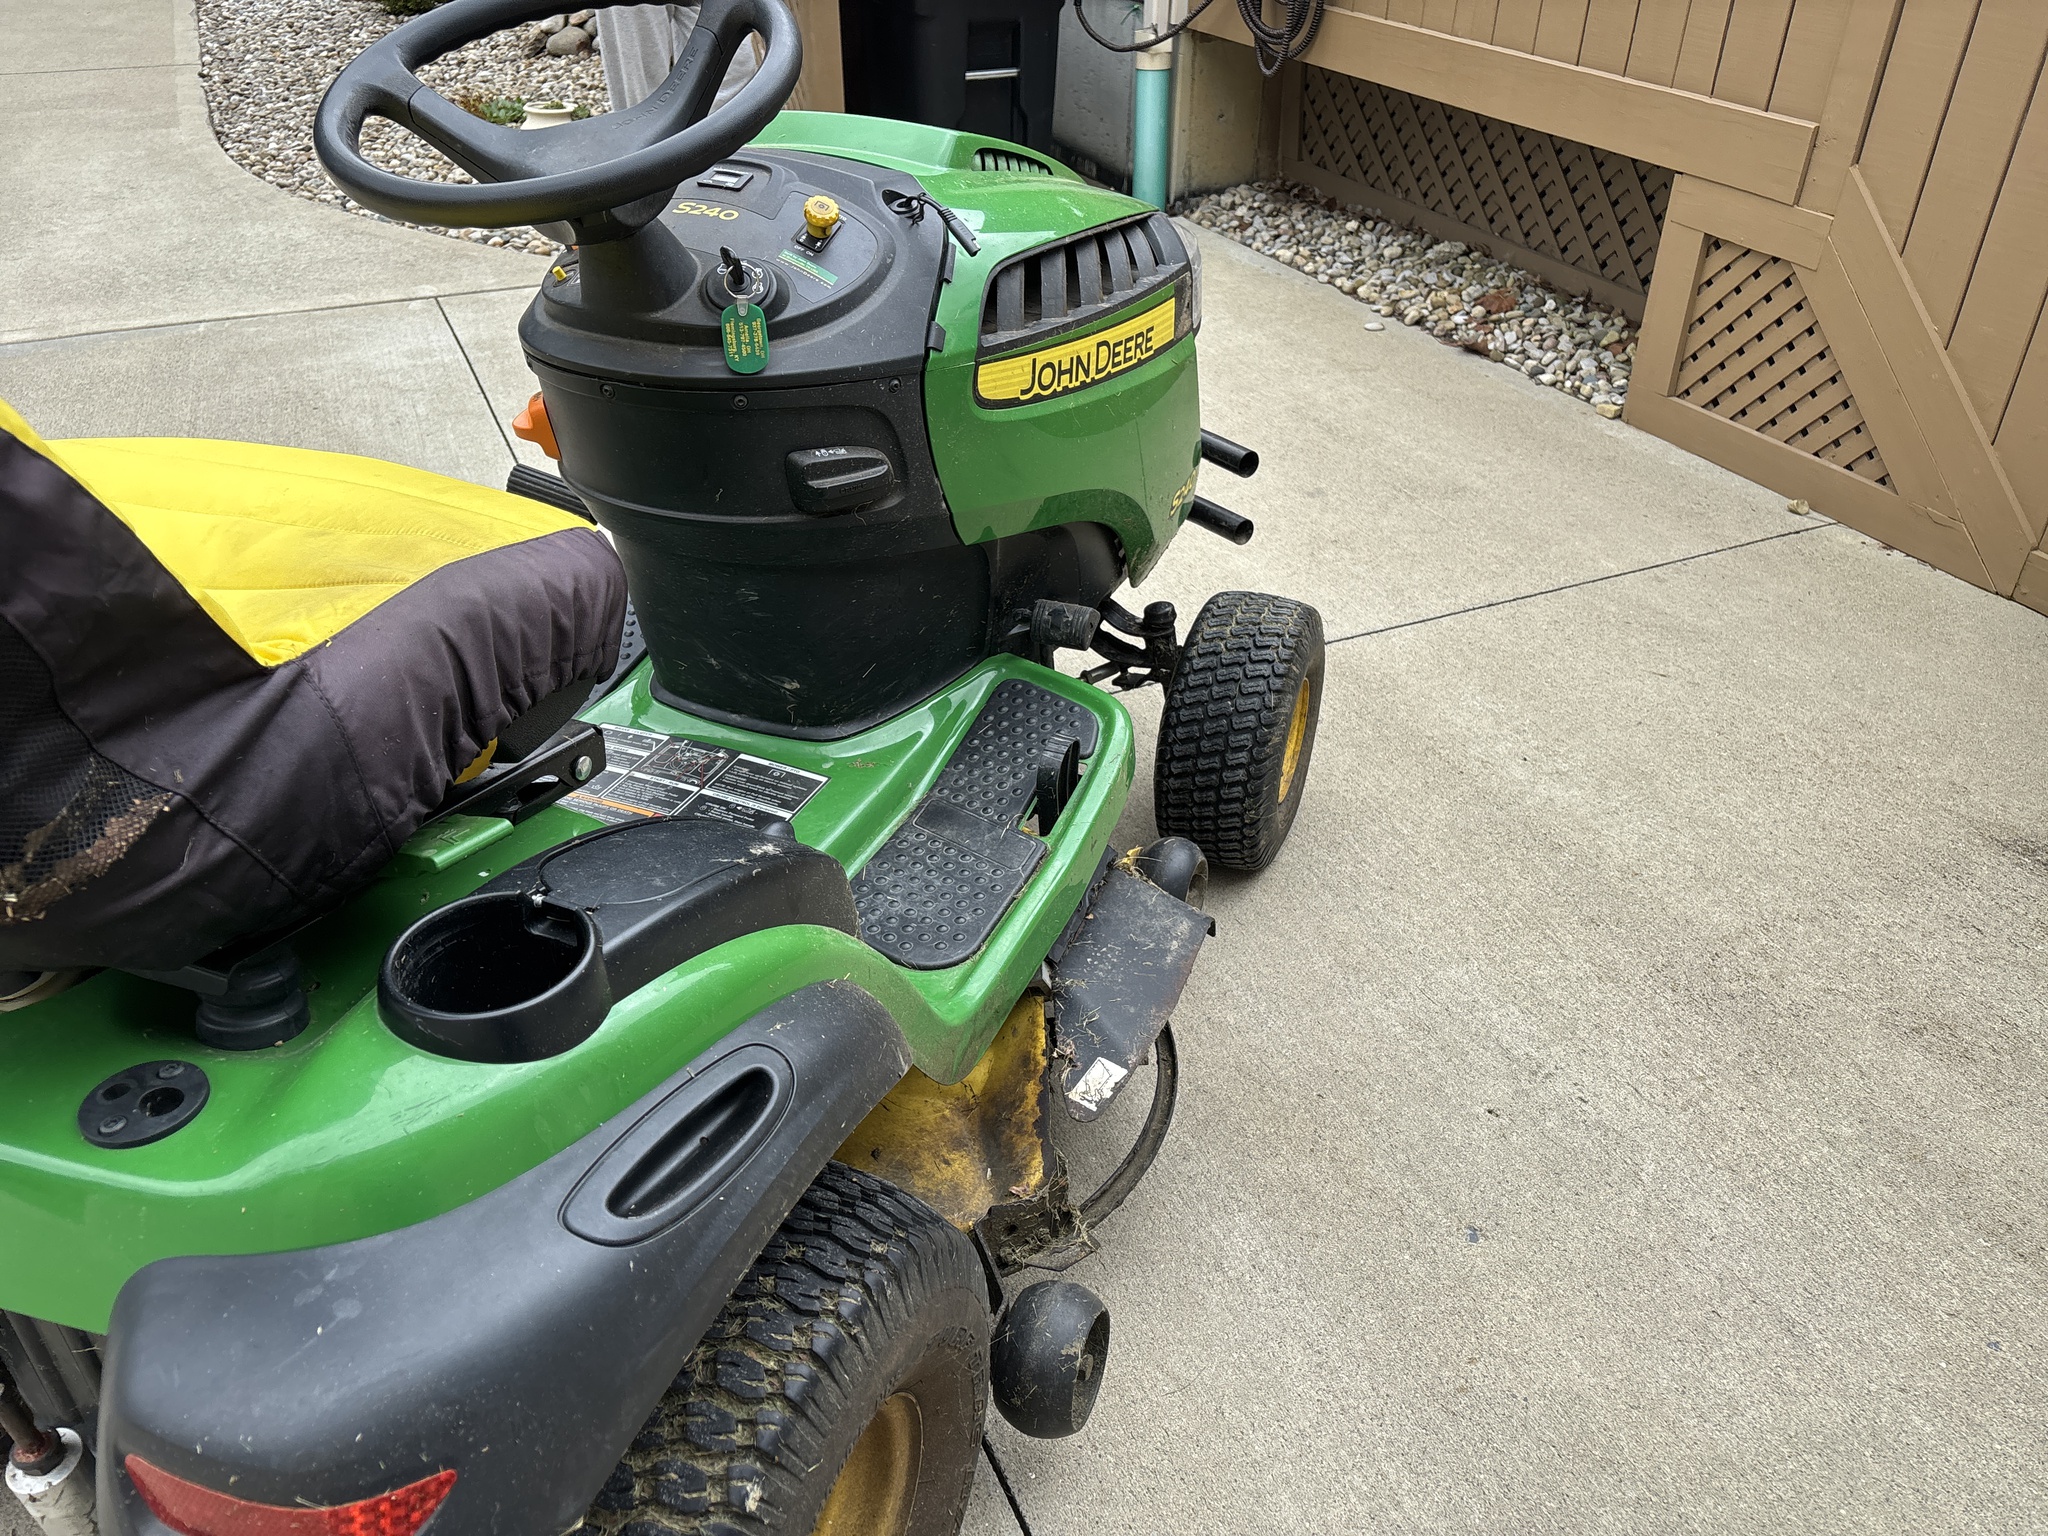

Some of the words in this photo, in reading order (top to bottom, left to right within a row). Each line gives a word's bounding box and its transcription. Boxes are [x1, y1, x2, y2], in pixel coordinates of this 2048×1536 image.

[657, 46, 699, 106] DEERE
[672, 201, 740, 221] S240
[1020, 352, 1090, 396] JOHN
[1095, 326, 1155, 376] DEERE
